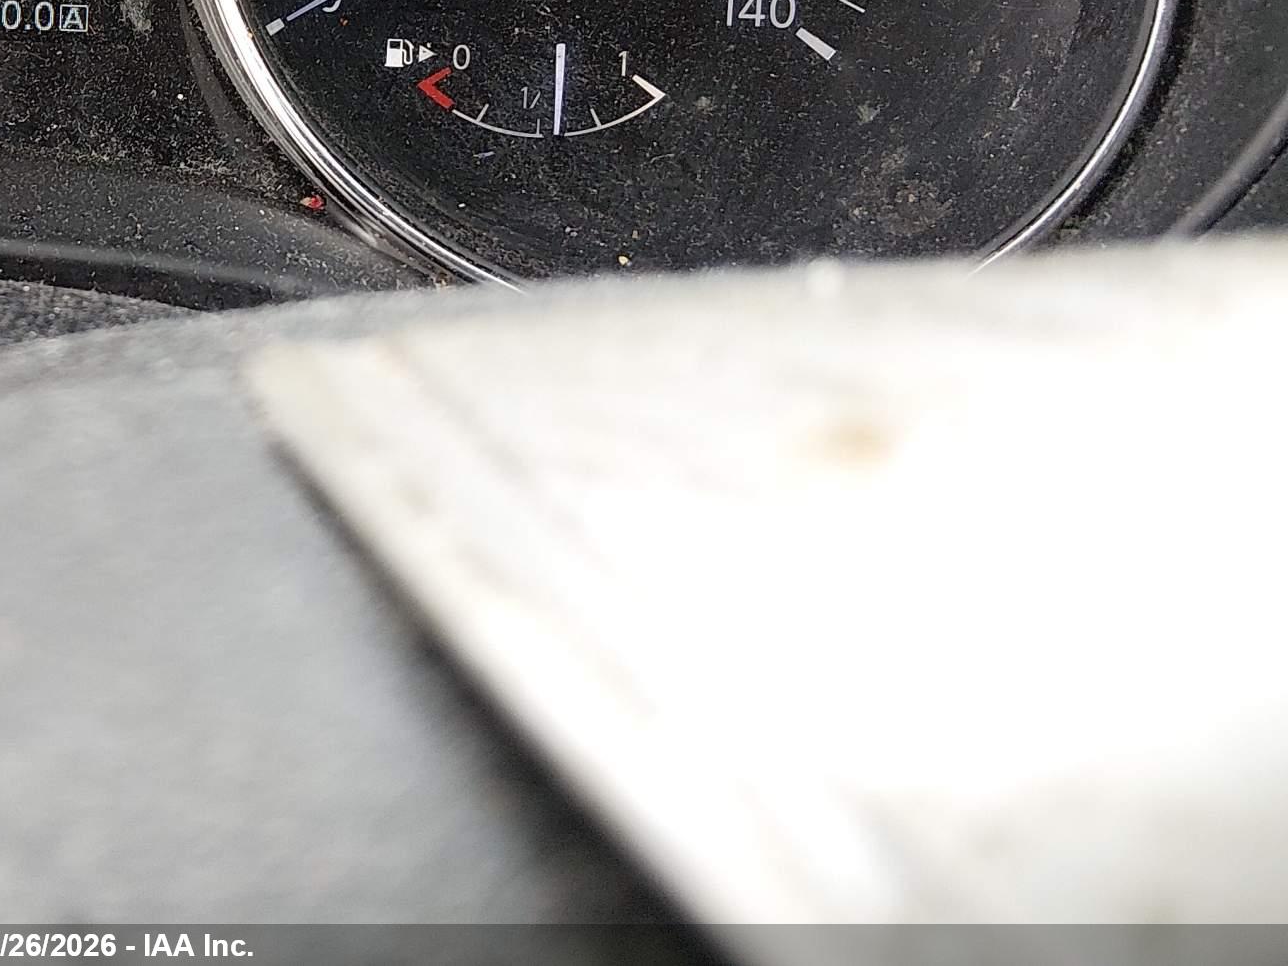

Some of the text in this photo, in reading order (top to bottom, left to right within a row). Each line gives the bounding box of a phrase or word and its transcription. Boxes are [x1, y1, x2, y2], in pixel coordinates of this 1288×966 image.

[1, 0, 55, 31] 0.0
[452, 44, 471, 70] 0
[618, 50, 628, 77] 1
